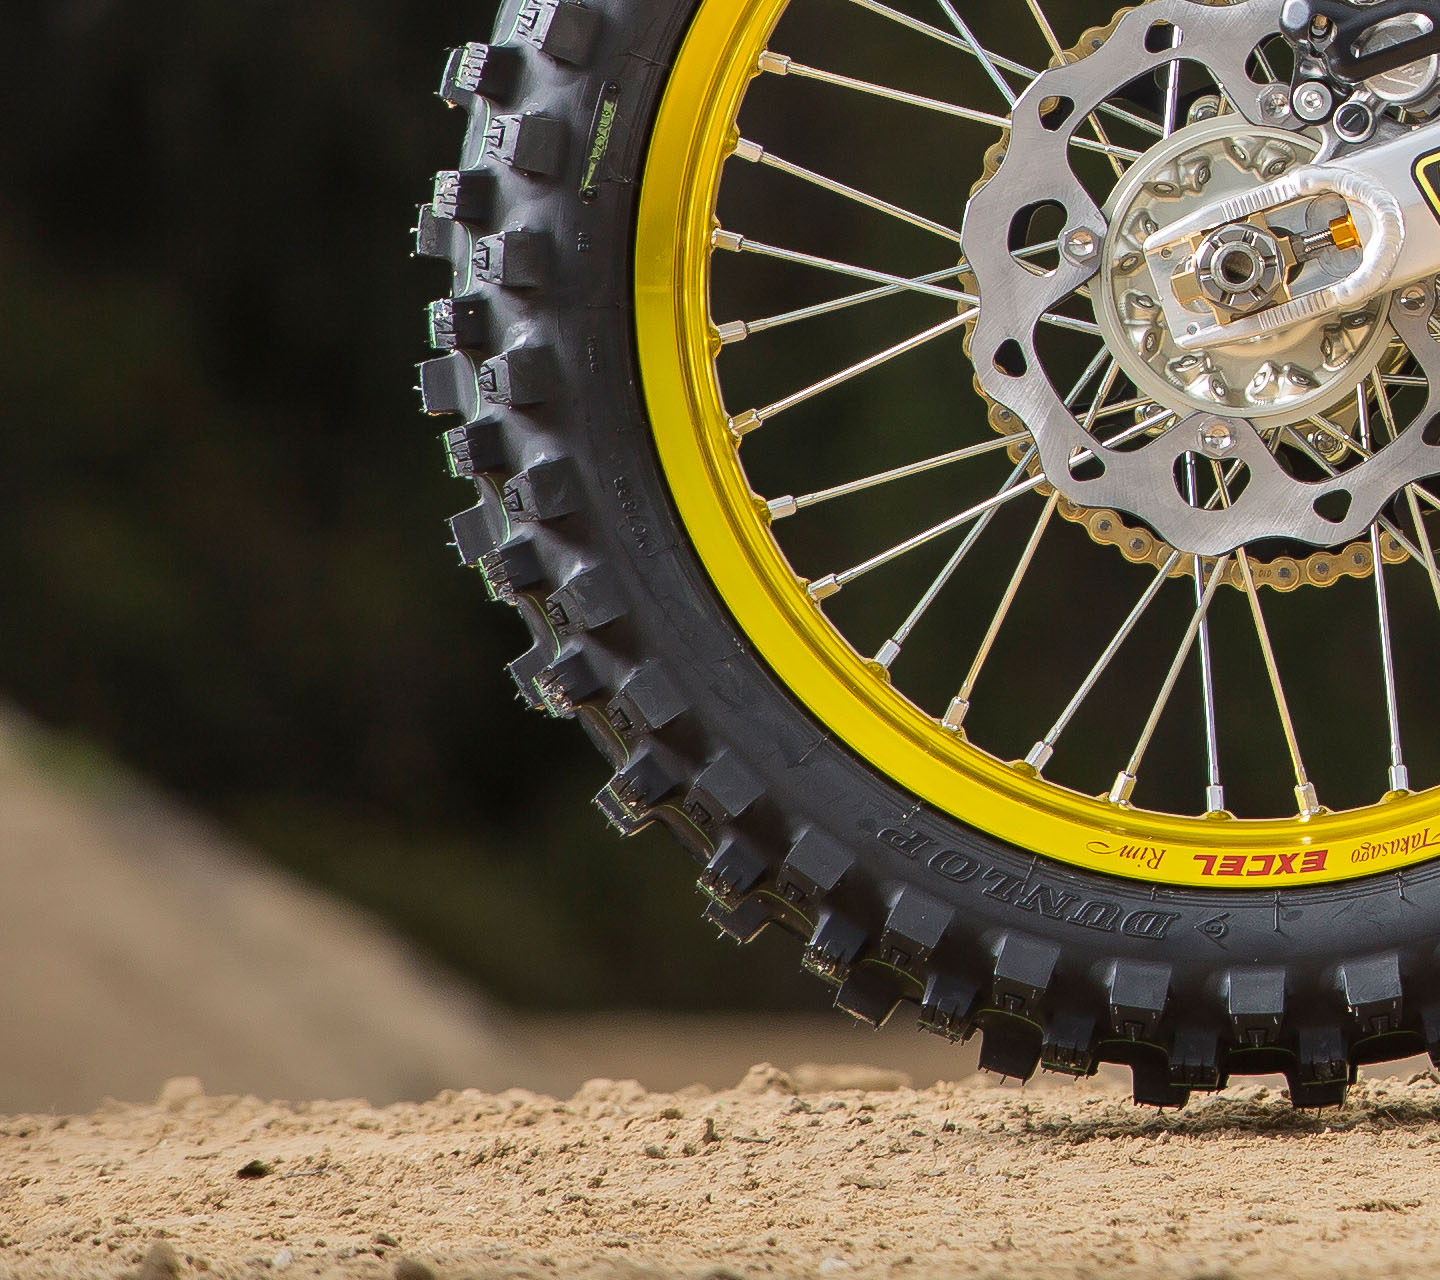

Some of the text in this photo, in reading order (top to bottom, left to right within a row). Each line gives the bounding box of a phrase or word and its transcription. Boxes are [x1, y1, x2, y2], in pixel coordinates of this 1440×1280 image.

[1086, 840, 1167, 871] Rim
[1194, 849, 1328, 877] EXCEL
[876, 823, 1181, 941] DUNLOP
